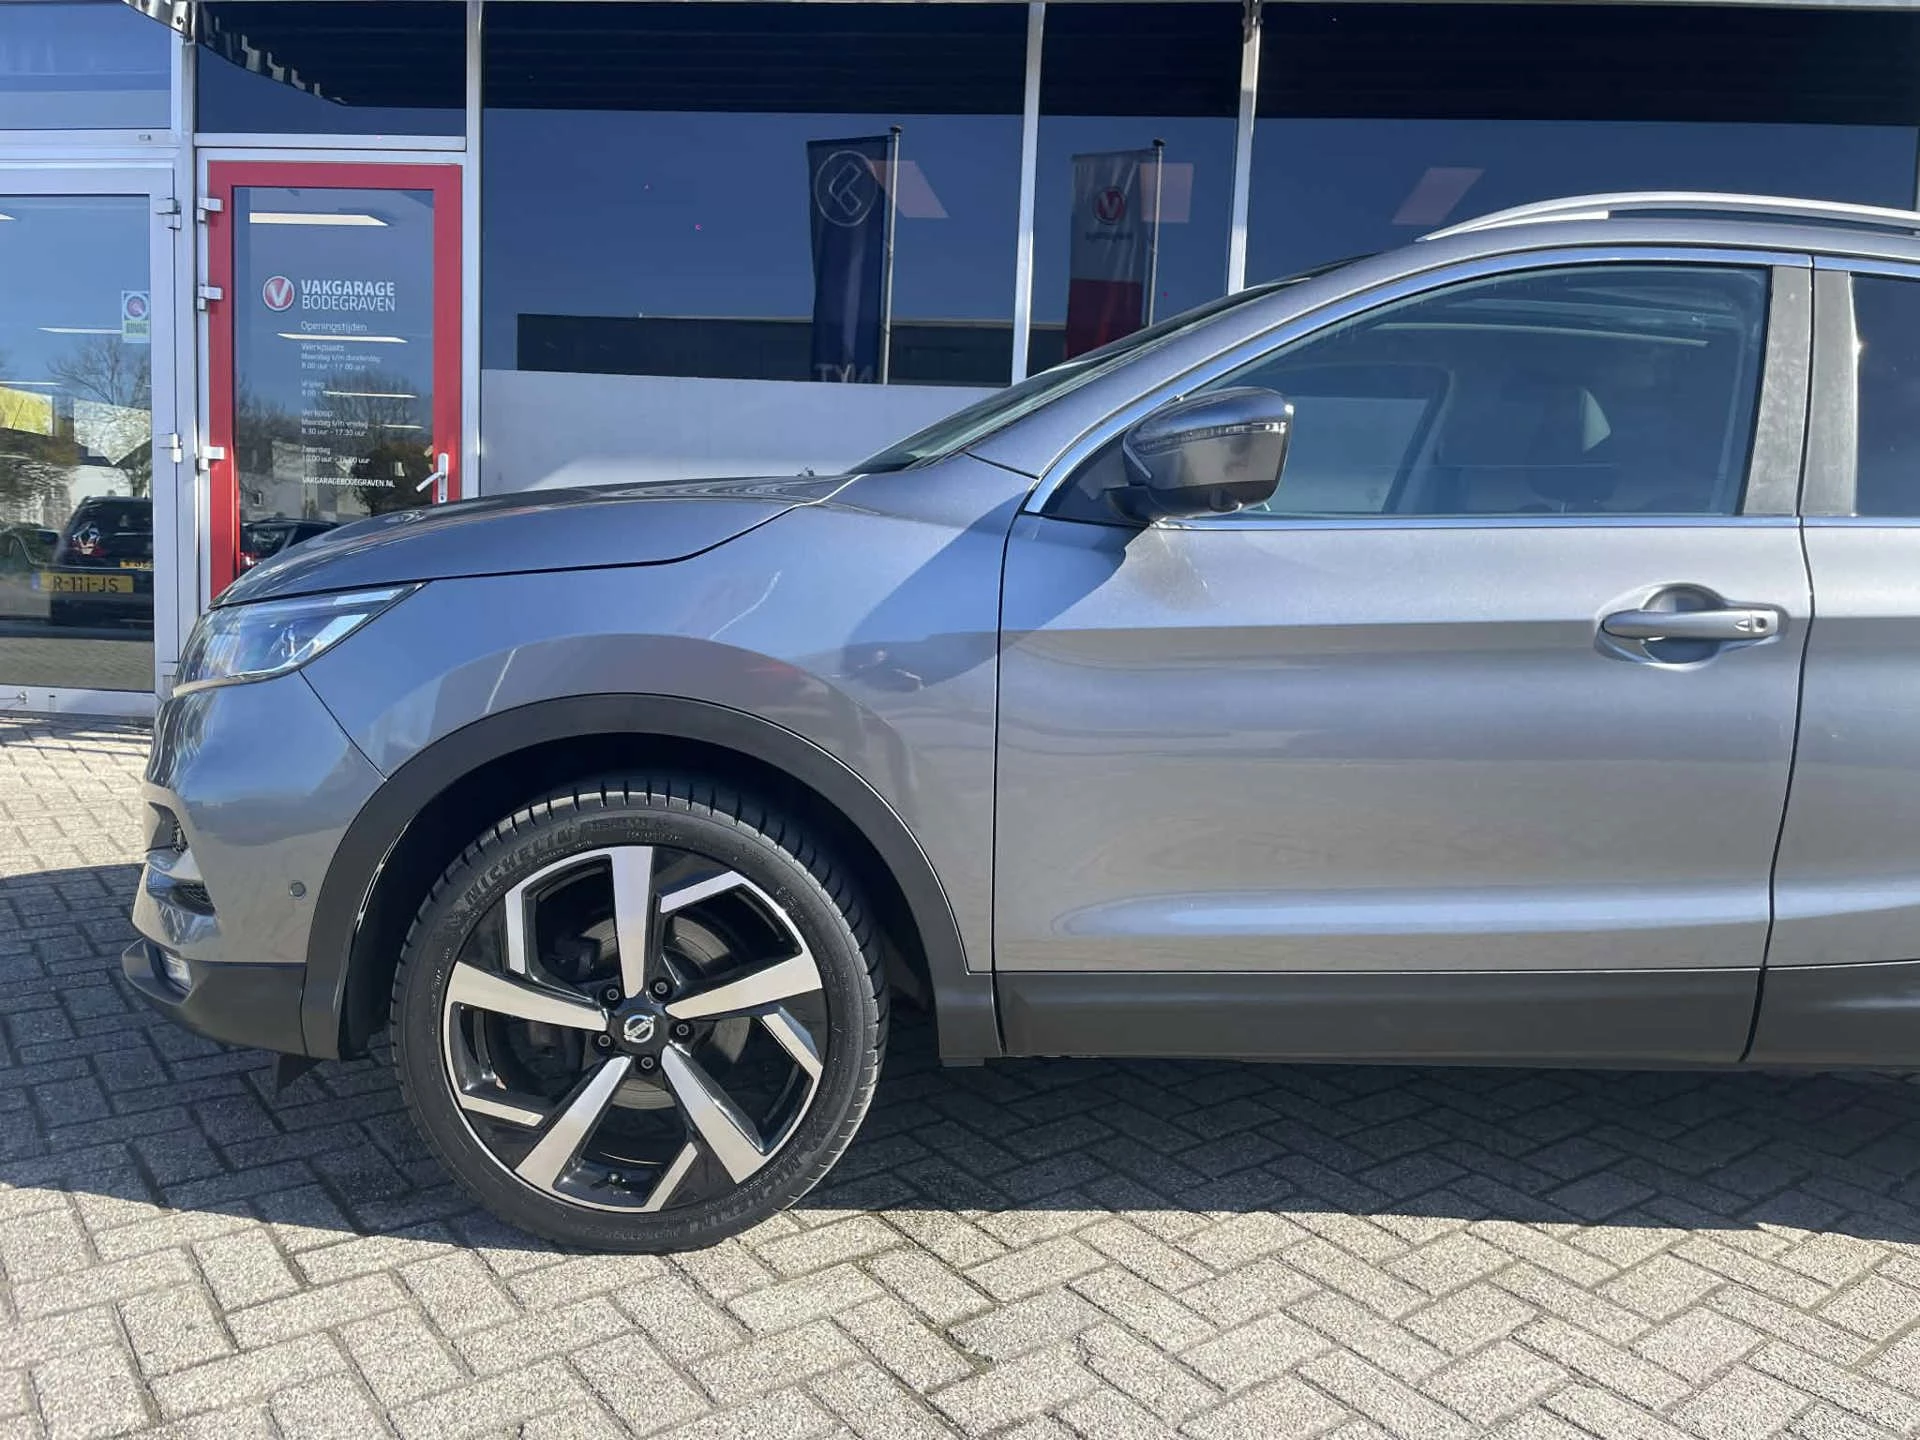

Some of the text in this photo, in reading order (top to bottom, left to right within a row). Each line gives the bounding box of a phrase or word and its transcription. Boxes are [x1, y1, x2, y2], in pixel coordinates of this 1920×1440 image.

[301, 280, 395, 296] VAKGARAGE
[302, 295, 395, 312] BODEGRAVEN
[301, 321, 367, 333] Openingstijden
